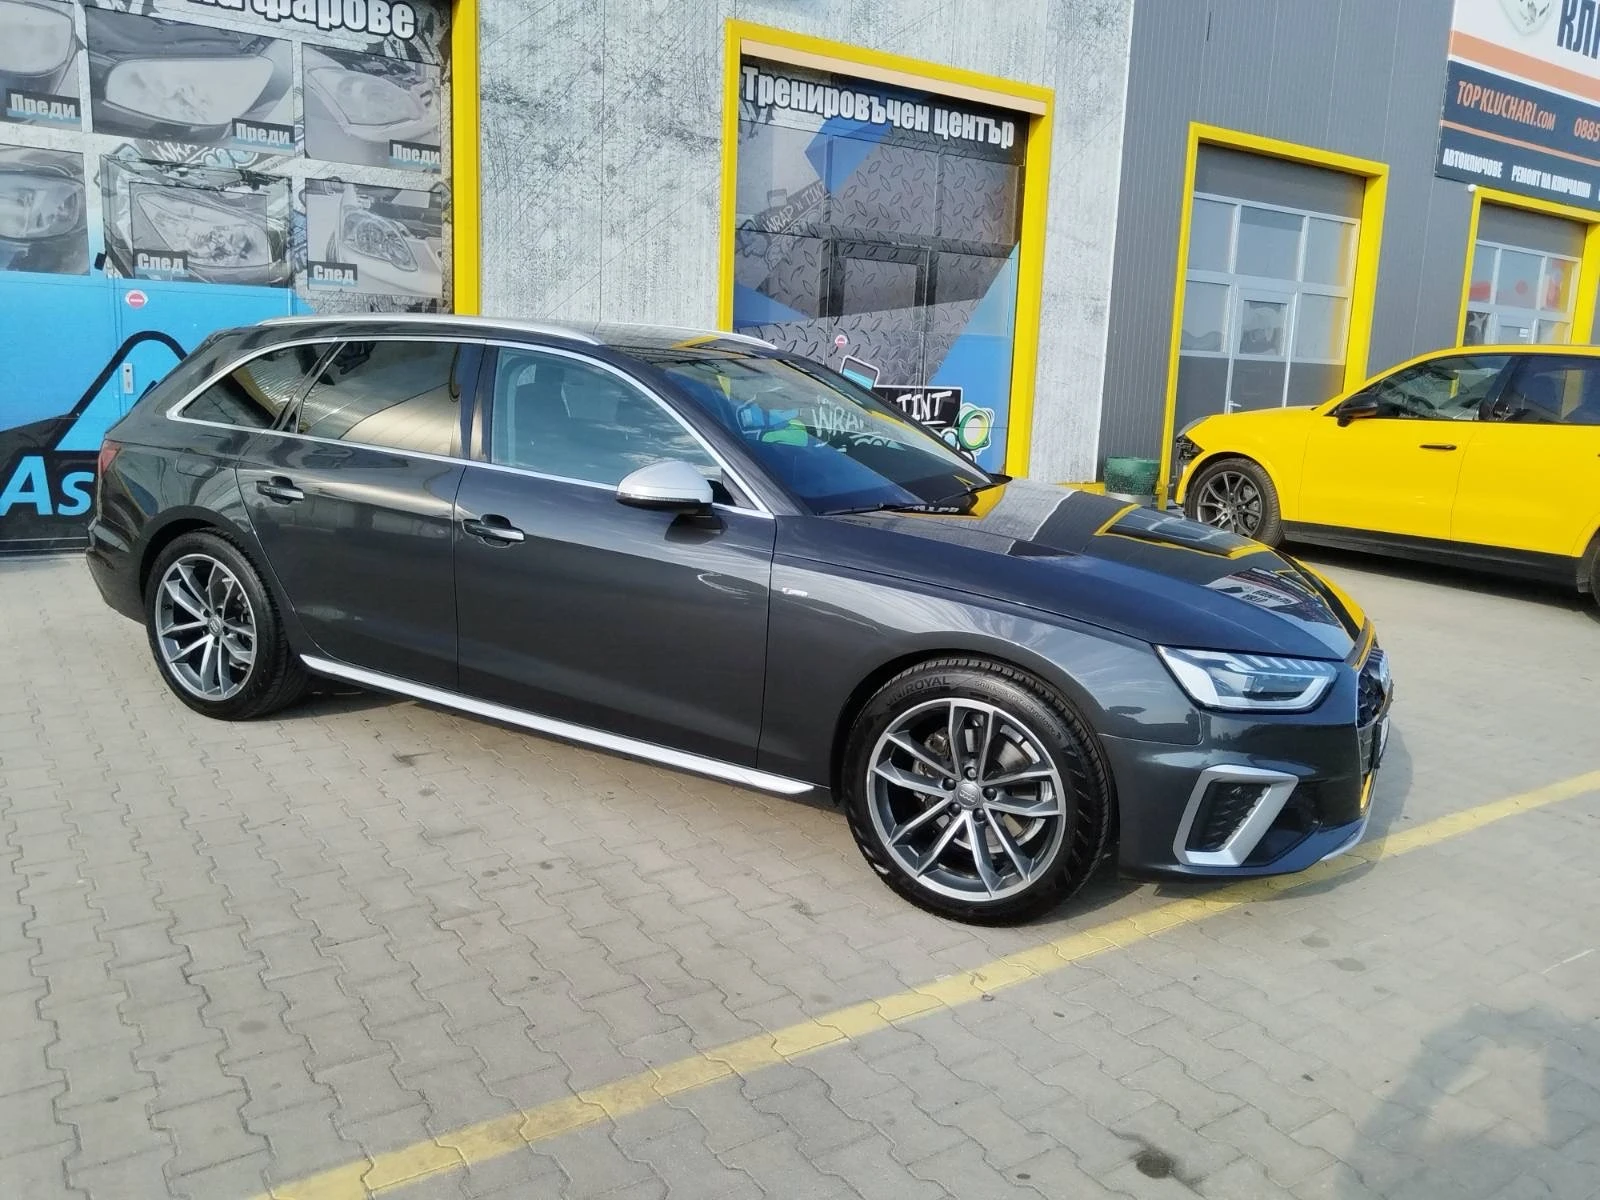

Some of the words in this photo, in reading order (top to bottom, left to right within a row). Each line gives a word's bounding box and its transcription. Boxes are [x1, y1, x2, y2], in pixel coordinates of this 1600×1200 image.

[10, 92, 77, 120] Преди
[741, 64, 931, 132] Тренировъчен
[933, 108, 1015, 149] център
[235, 122, 291, 146] Преди
[392, 143, 441, 166] Преди
[137, 252, 185, 275] След
[313, 264, 355, 285] След
[896, 390, 952, 422] TINT
[886, 675, 951, 706] NIROYAL
